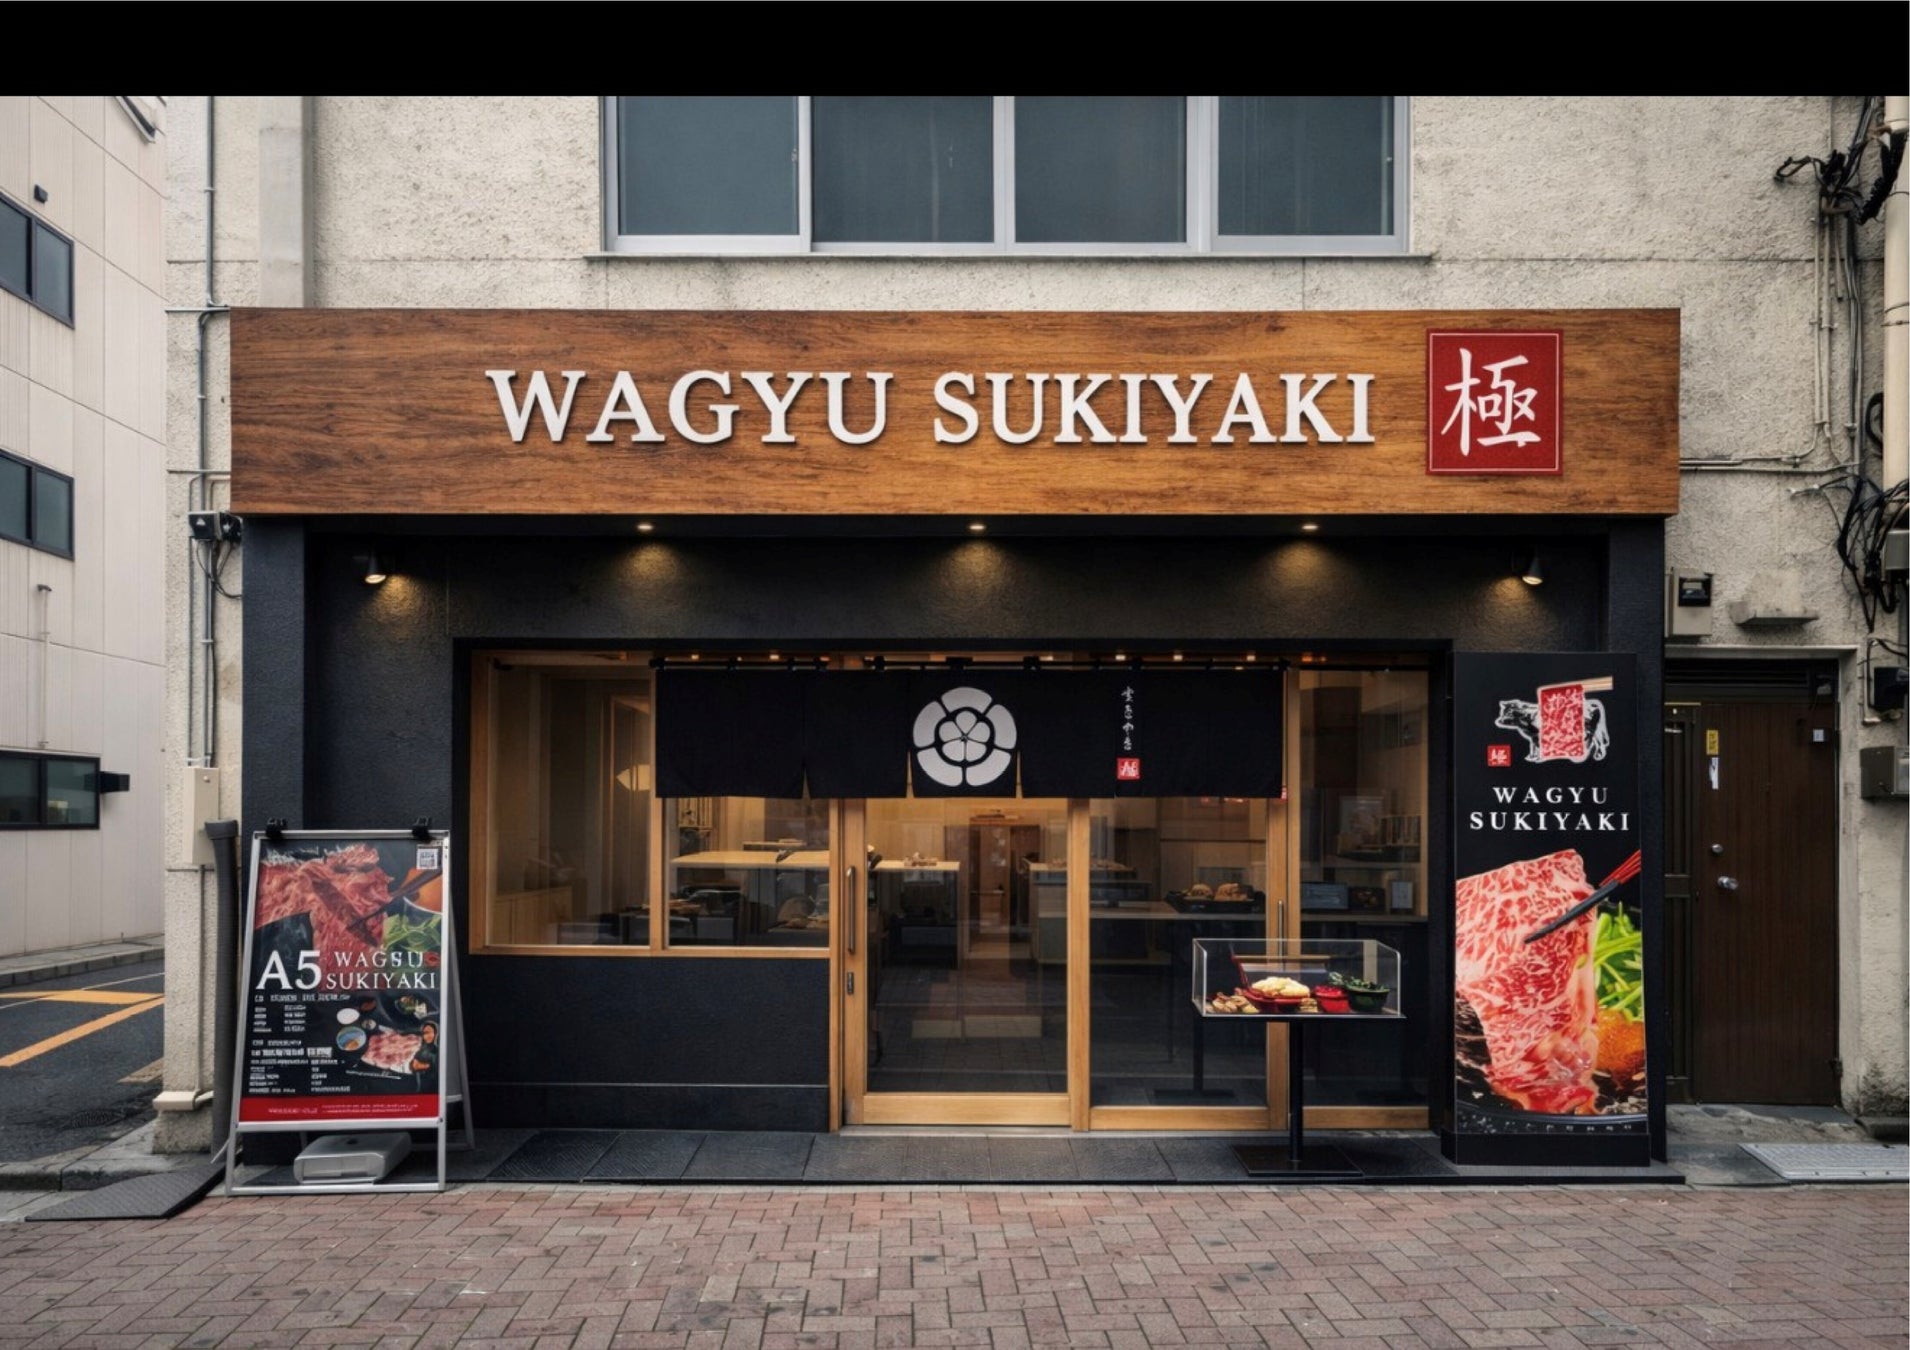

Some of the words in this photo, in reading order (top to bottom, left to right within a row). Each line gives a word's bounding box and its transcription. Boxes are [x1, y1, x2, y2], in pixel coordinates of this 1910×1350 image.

[484, 369, 895, 444] WAGYU
[932, 371, 1376, 445] SUKIYAKI
[1440, 347, 1542, 457] 極
[1491, 785, 1609, 805] WAGYU
[1469, 811, 1630, 832] SUKIYAKI
[255, 949, 322, 991] A5
[325, 971, 436, 991] SUKIYAKI
